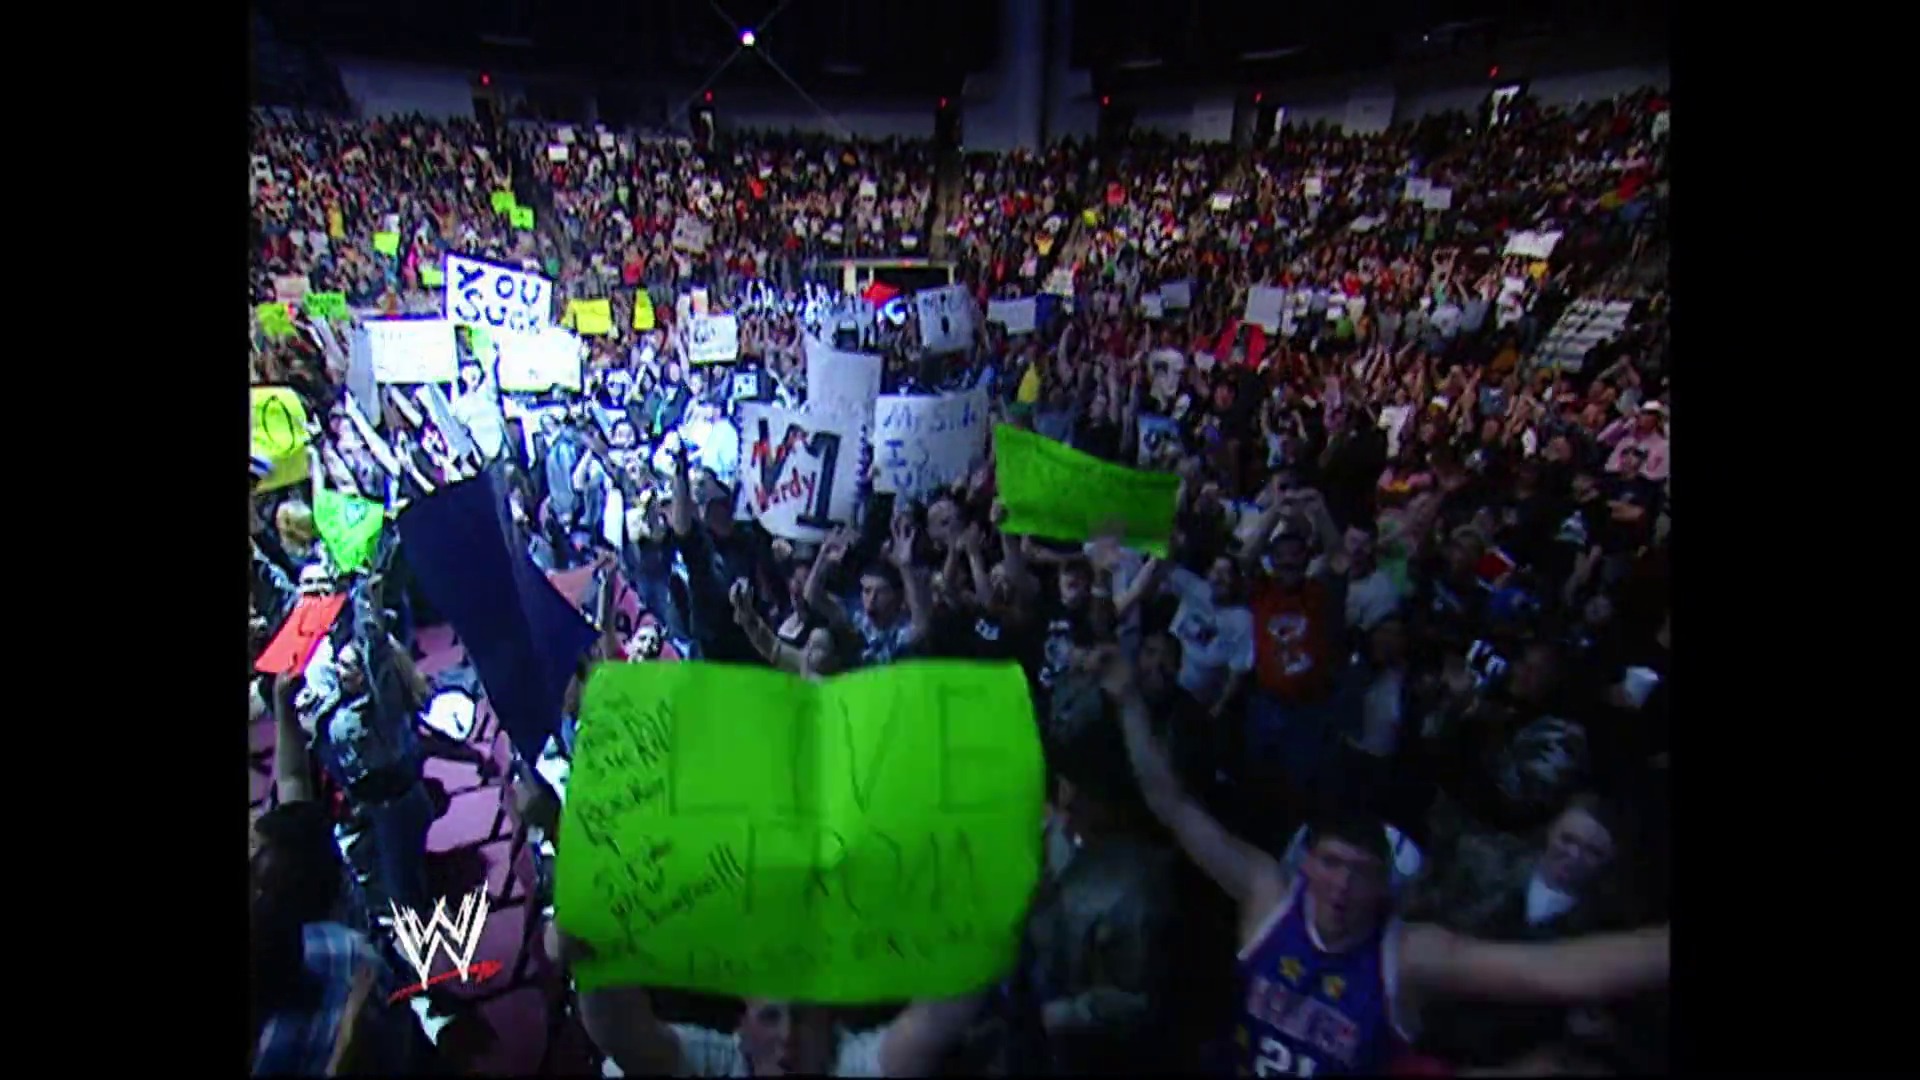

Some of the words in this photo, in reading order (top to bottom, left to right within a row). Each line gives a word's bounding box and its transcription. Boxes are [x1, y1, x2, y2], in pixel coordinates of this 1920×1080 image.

[457, 264, 541, 307] YOU
[668, 682, 1010, 815] LIVE
[743, 820, 984, 920] FROM
